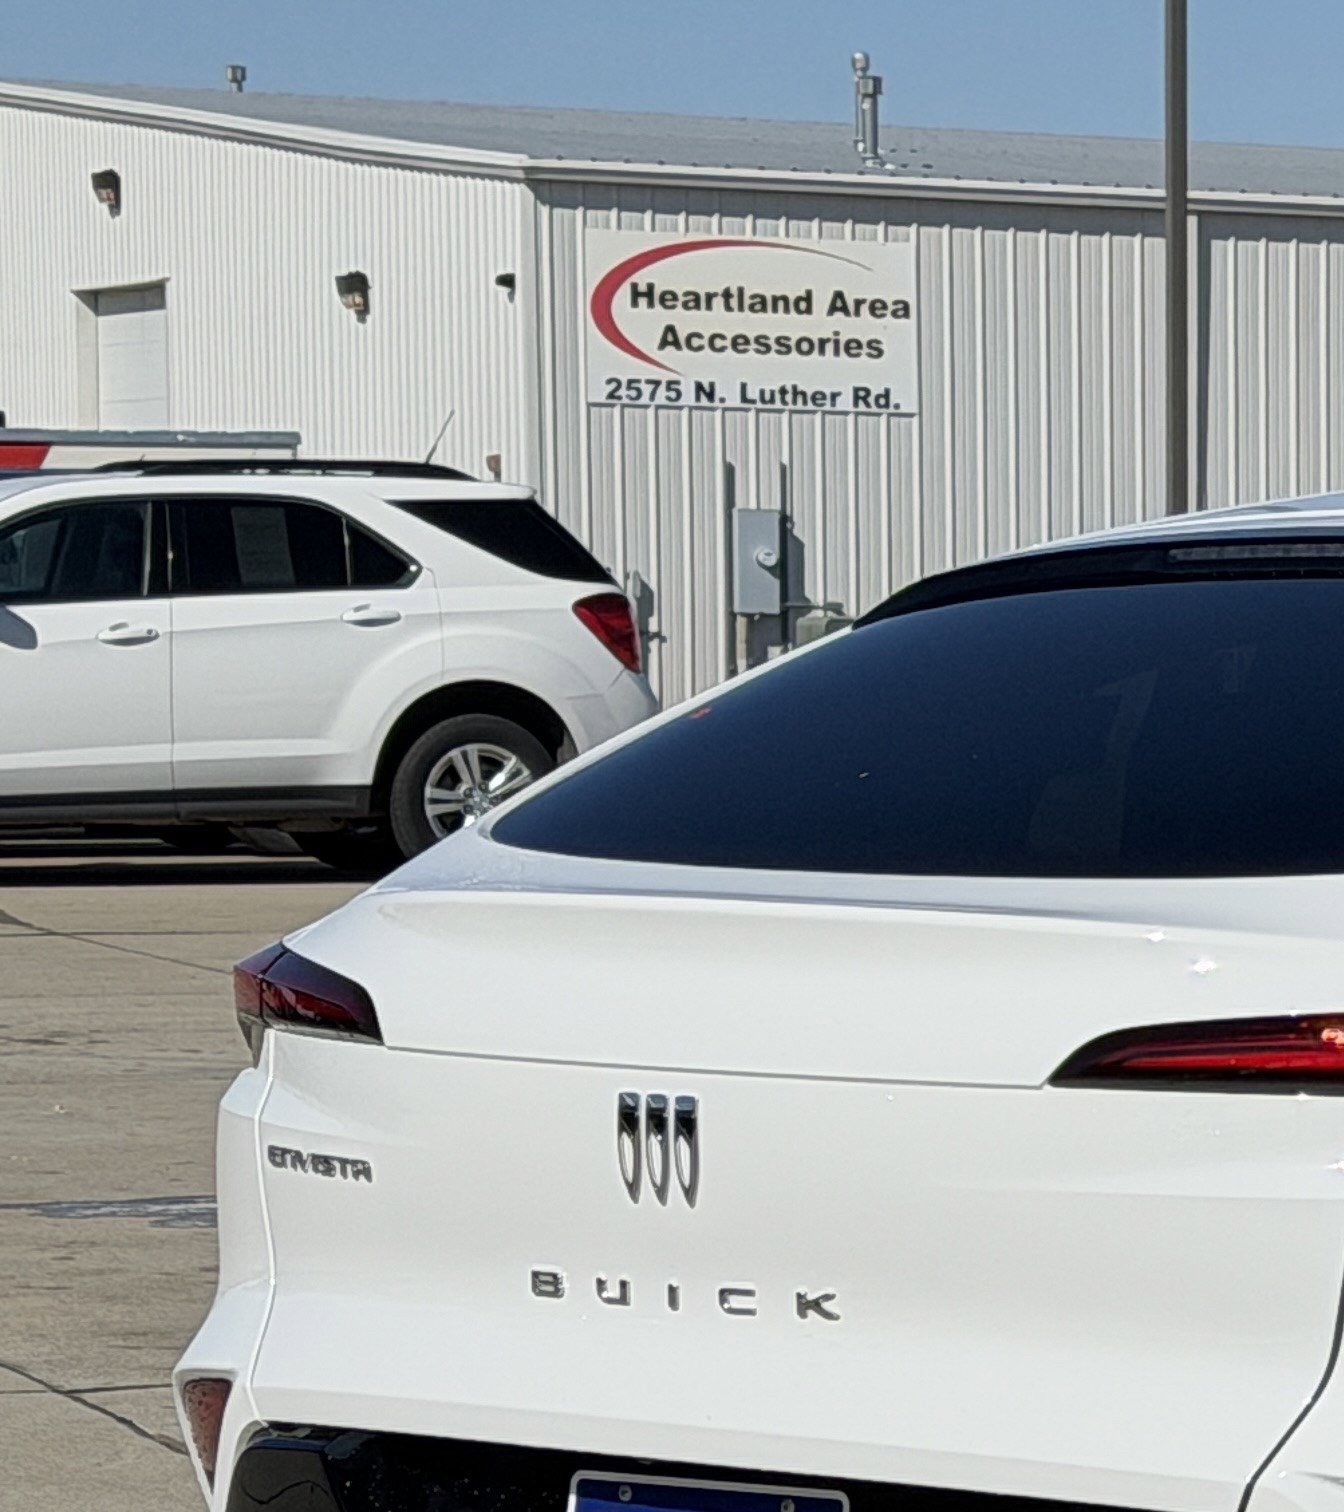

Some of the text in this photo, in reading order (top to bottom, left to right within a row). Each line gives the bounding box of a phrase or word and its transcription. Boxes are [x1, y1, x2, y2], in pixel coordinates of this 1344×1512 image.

[629, 281, 911, 320] Heartland Area
[656, 324, 885, 360] Accessories
[604, 377, 901, 410] 2575 N. Luther Rd.
[530, 1270, 842, 1321] BUICK
